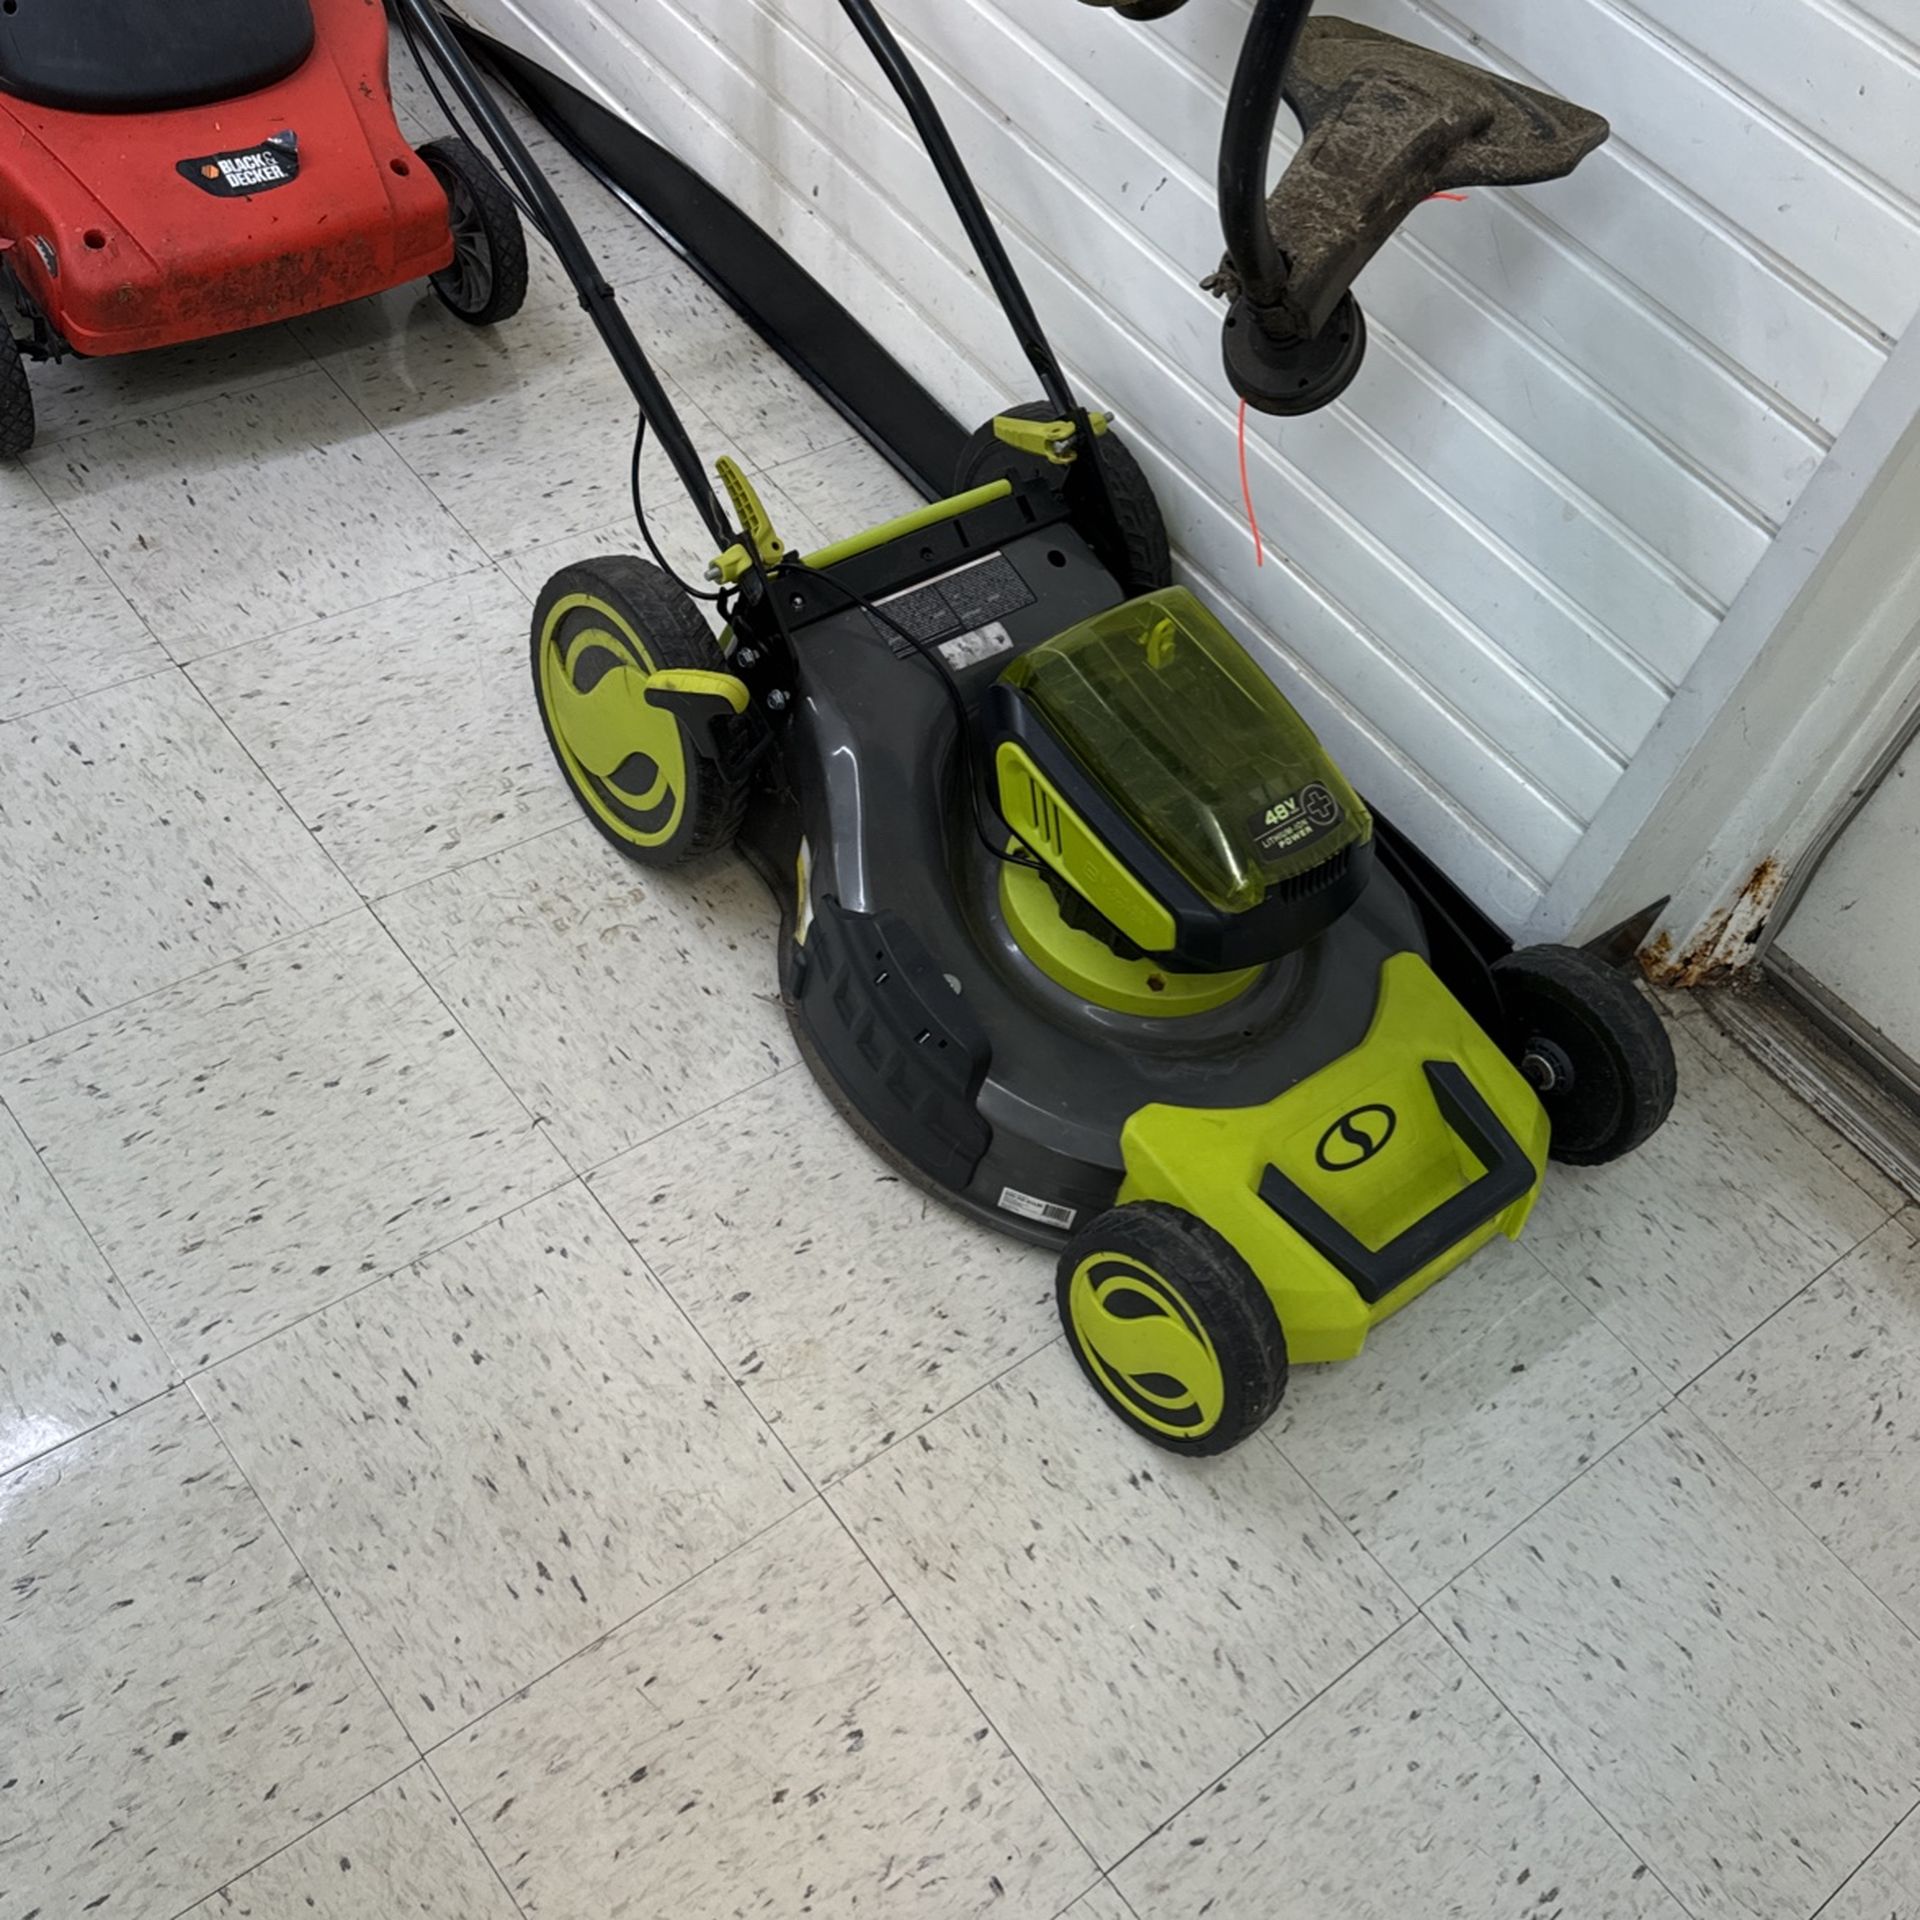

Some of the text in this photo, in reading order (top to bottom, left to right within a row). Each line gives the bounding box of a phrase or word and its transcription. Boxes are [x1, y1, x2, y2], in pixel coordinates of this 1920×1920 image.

[218, 152, 278, 174] BLACK &
[226, 165, 284, 187] DECKER
[1265, 797, 1296, 825] 48V
[1279, 826, 1313, 848] POWER
